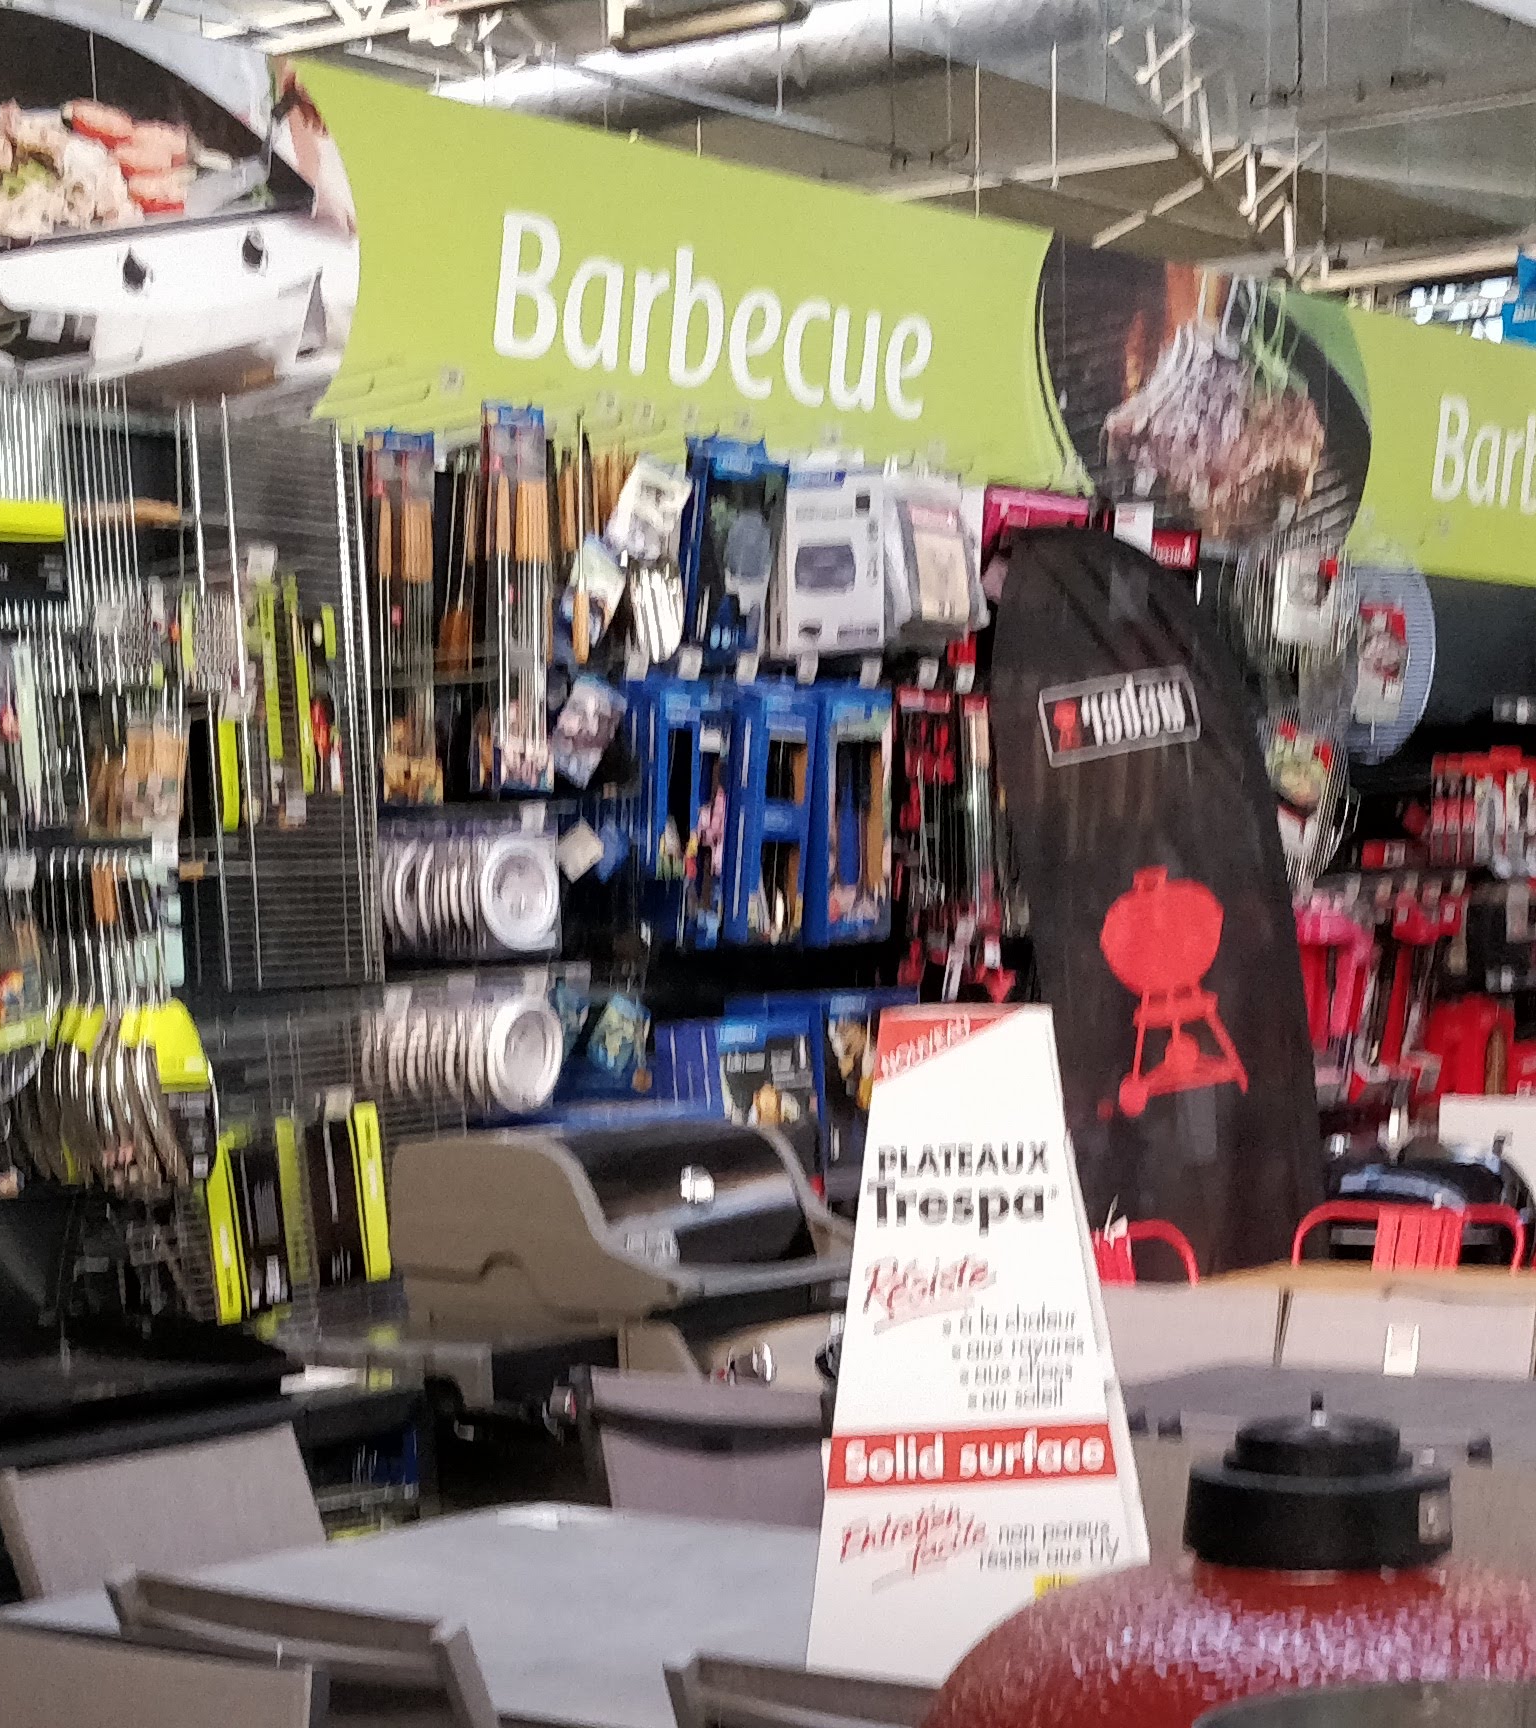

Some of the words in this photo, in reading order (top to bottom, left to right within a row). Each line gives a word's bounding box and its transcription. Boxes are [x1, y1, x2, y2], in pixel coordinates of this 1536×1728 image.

[492, 208, 932, 420] Barbecue
[877, 1140, 1049, 1181] PLATEAUX
[844, 1431, 944, 1484] Solid
[958, 1427, 1106, 1479] surface
